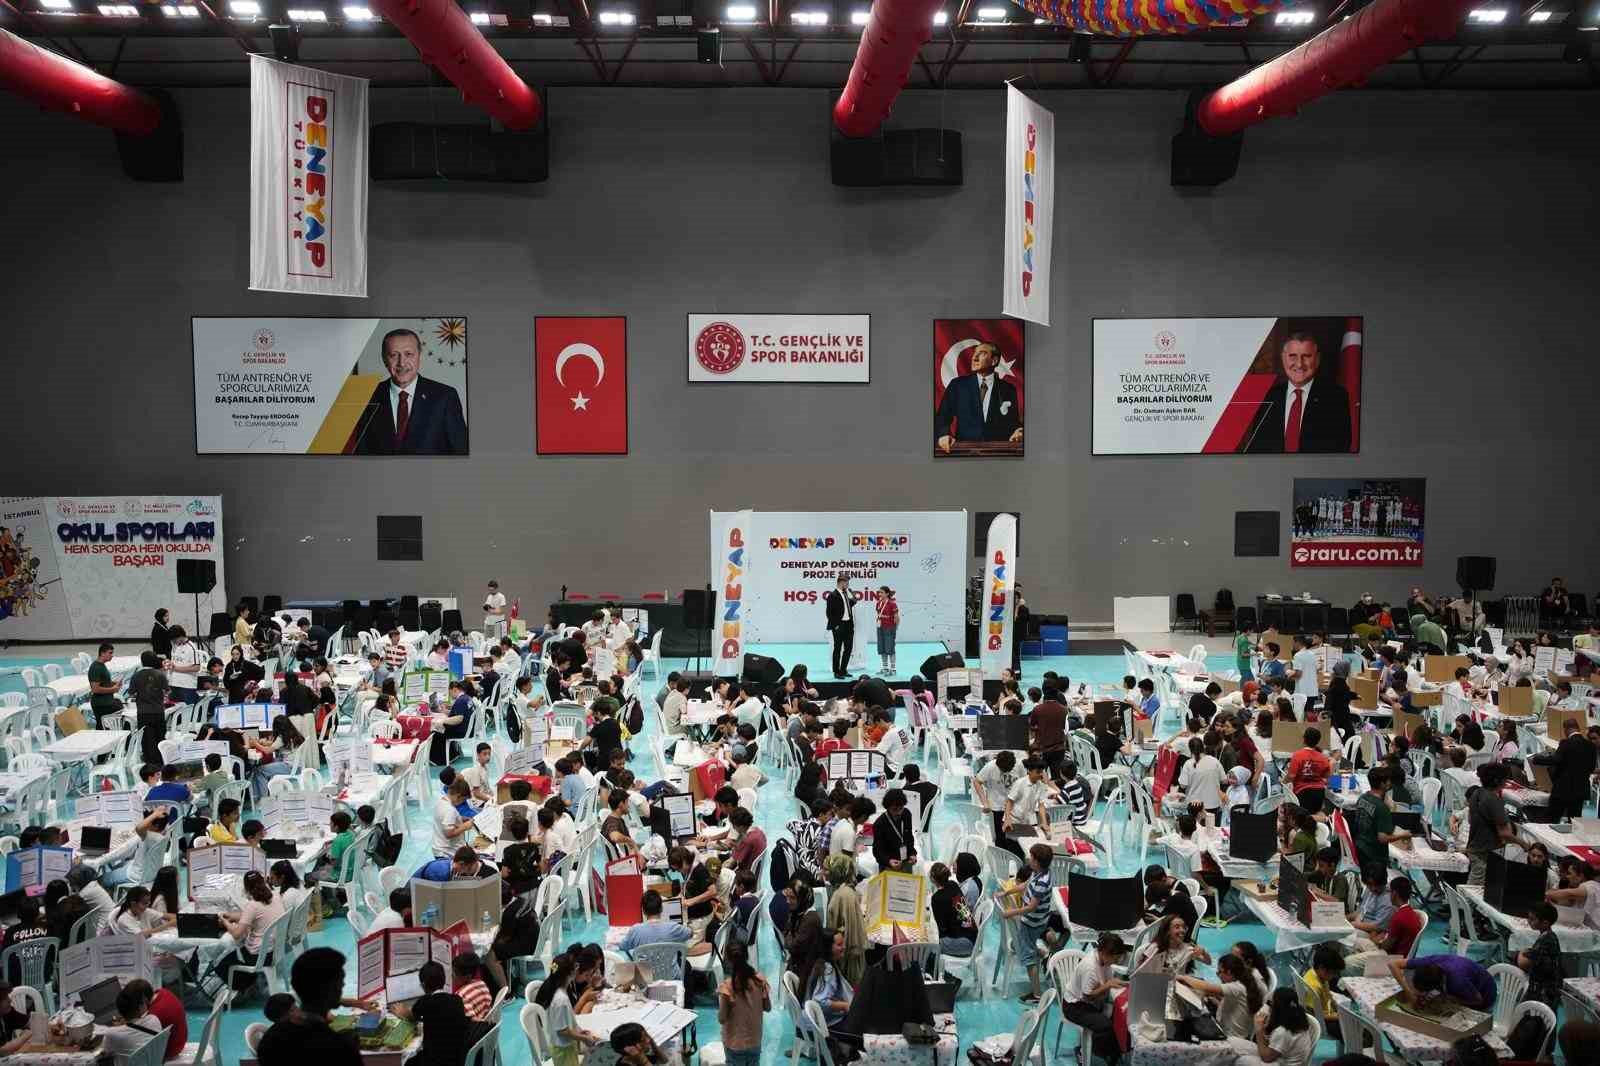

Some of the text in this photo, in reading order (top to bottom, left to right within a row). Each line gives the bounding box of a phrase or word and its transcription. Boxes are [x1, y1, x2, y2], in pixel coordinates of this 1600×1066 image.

[294, 120, 305, 240] TÜRKİYE
[306, 95, 328, 269] DENEYAP
[751, 332, 863, 349] T.C. GENÇLİK VE
[751, 349, 864, 363] SPOR BAKANLIĞI
[216, 372, 312, 382] TÜM ANTRENÖR VE
[1119, 372, 1211, 383] TÜM ANTRENÖR VE
[220, 383, 310, 393] SPORCULARIMIZA
[1122, 383, 1208, 393] SPORCULARIMIZA
[215, 394, 315, 405] BAŞARILAR DİLİYORUM
[1117, 393, 1213, 405] BAŞARILAR DİLİYORUM
[56, 520, 215, 543] OKUL SPORLARI
[769, 537, 835, 549] DENEYAP
[852, 536, 908, 546] DENEYAP
[64, 543, 211, 554] HEM SPORDA HEM OKULDA
[113, 555, 164, 568] BAŞARI
[780, 559, 900, 569] DENEYAP DÖNEM SONU
[802, 570, 836, 579] PROJE
[722, 527, 745, 659] DENEYAP
[784, 590, 818, 604] HOŞ
[988, 550, 1006, 651] DENEYAP
[13, 927, 48, 941] FOLLOW
